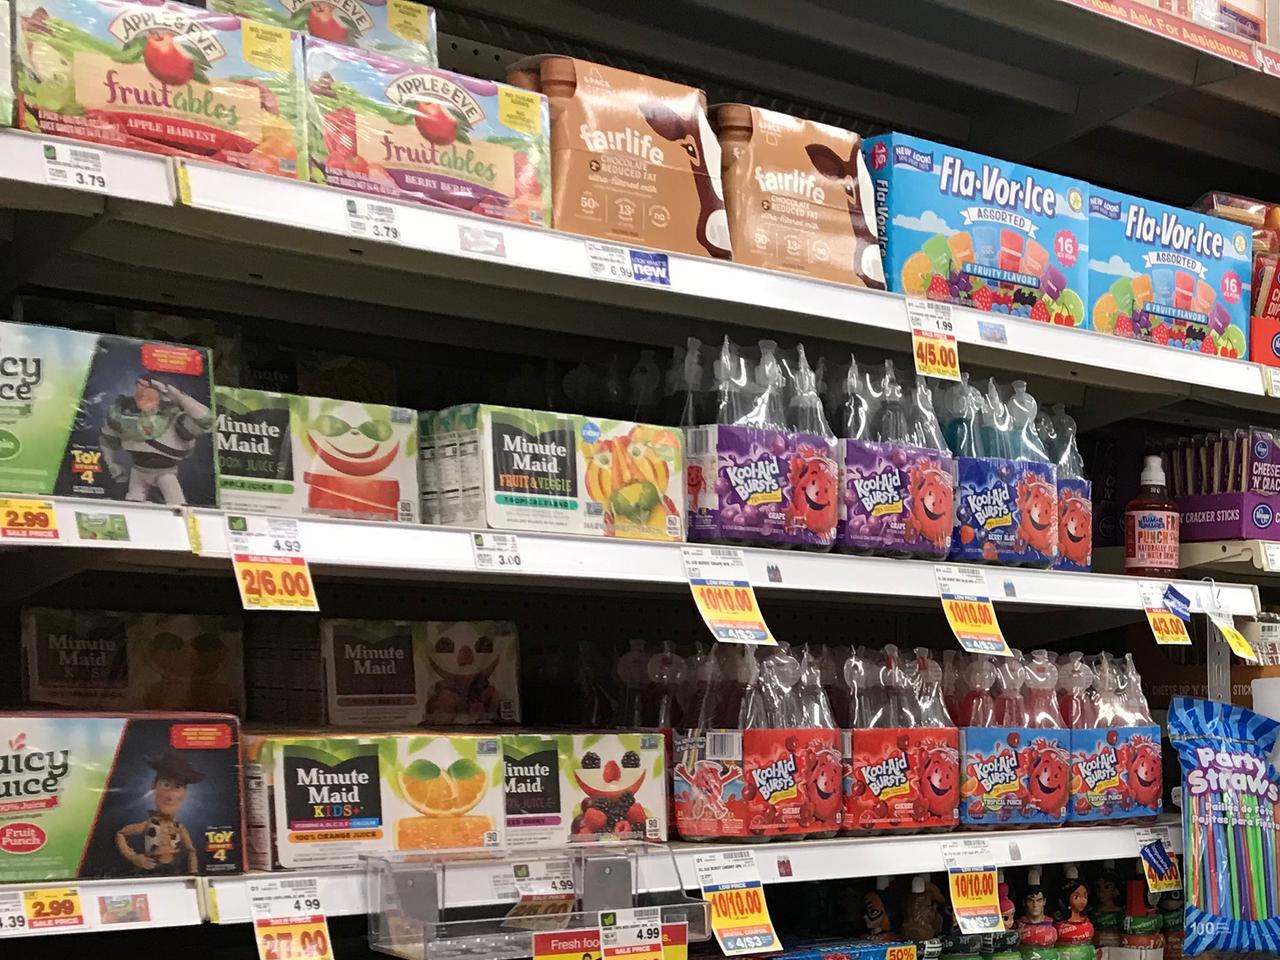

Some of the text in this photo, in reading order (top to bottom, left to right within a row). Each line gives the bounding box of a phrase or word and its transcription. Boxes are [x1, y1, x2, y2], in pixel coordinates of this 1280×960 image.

[103, 70, 237, 124] fruitables
[127, 118, 162, 133] APPLE
[166, 123, 216, 143] HARVEST
[380, 135, 496, 181] fruitables
[75, 173, 105, 187] 3.79
[977, 207, 1026, 228] ASSORTED
[373, 225, 398, 238] 3.79
[1057, 237, 1073, 254] 16
[1156, 252, 1197, 270] ASSORTED
[610, 265, 632, 278] 6.99
[633, 262, 668, 279] new
[1223, 276, 1237, 292] 16
[936, 320, 953, 332] 1.99
[916, 341, 957, 369] 4/5.00
[502, 433, 567, 457] Minute
[511, 453, 559, 474] Maid
[500, 475, 528, 493] FRUIT
[538, 477, 572, 493] VEGGIE
[5, 508, 50, 529] 2.99
[1185, 509, 1240, 523] CRACKER STICKS
[1138, 531, 1169, 544] PUNCH
[498, 554, 521, 566] 3.00
[242, 568, 311, 600] 2/6.00
[699, 588, 753, 612] 10/10.00
[949, 603, 992, 626] 10/10.00
[1152, 617, 1185, 635] 4/3.00
[343, 643, 404, 661] Minute
[353, 659, 397, 676] Maid
[1197, 747, 1266, 776] Party
[295, 767, 371, 787] Minute
[1188, 768, 1280, 801] Straws
[307, 786, 360, 805] Maid
[2, 836, 41, 846] Punch
[5, 828, 35, 838] Fruit
[953, 874, 994, 899] 10/10.00
[31, 899, 75, 917] 2.99
[292, 898, 322, 912] 4.99
[710, 888, 762, 919] 10/10.00
[635, 928, 660, 941] 4.99
